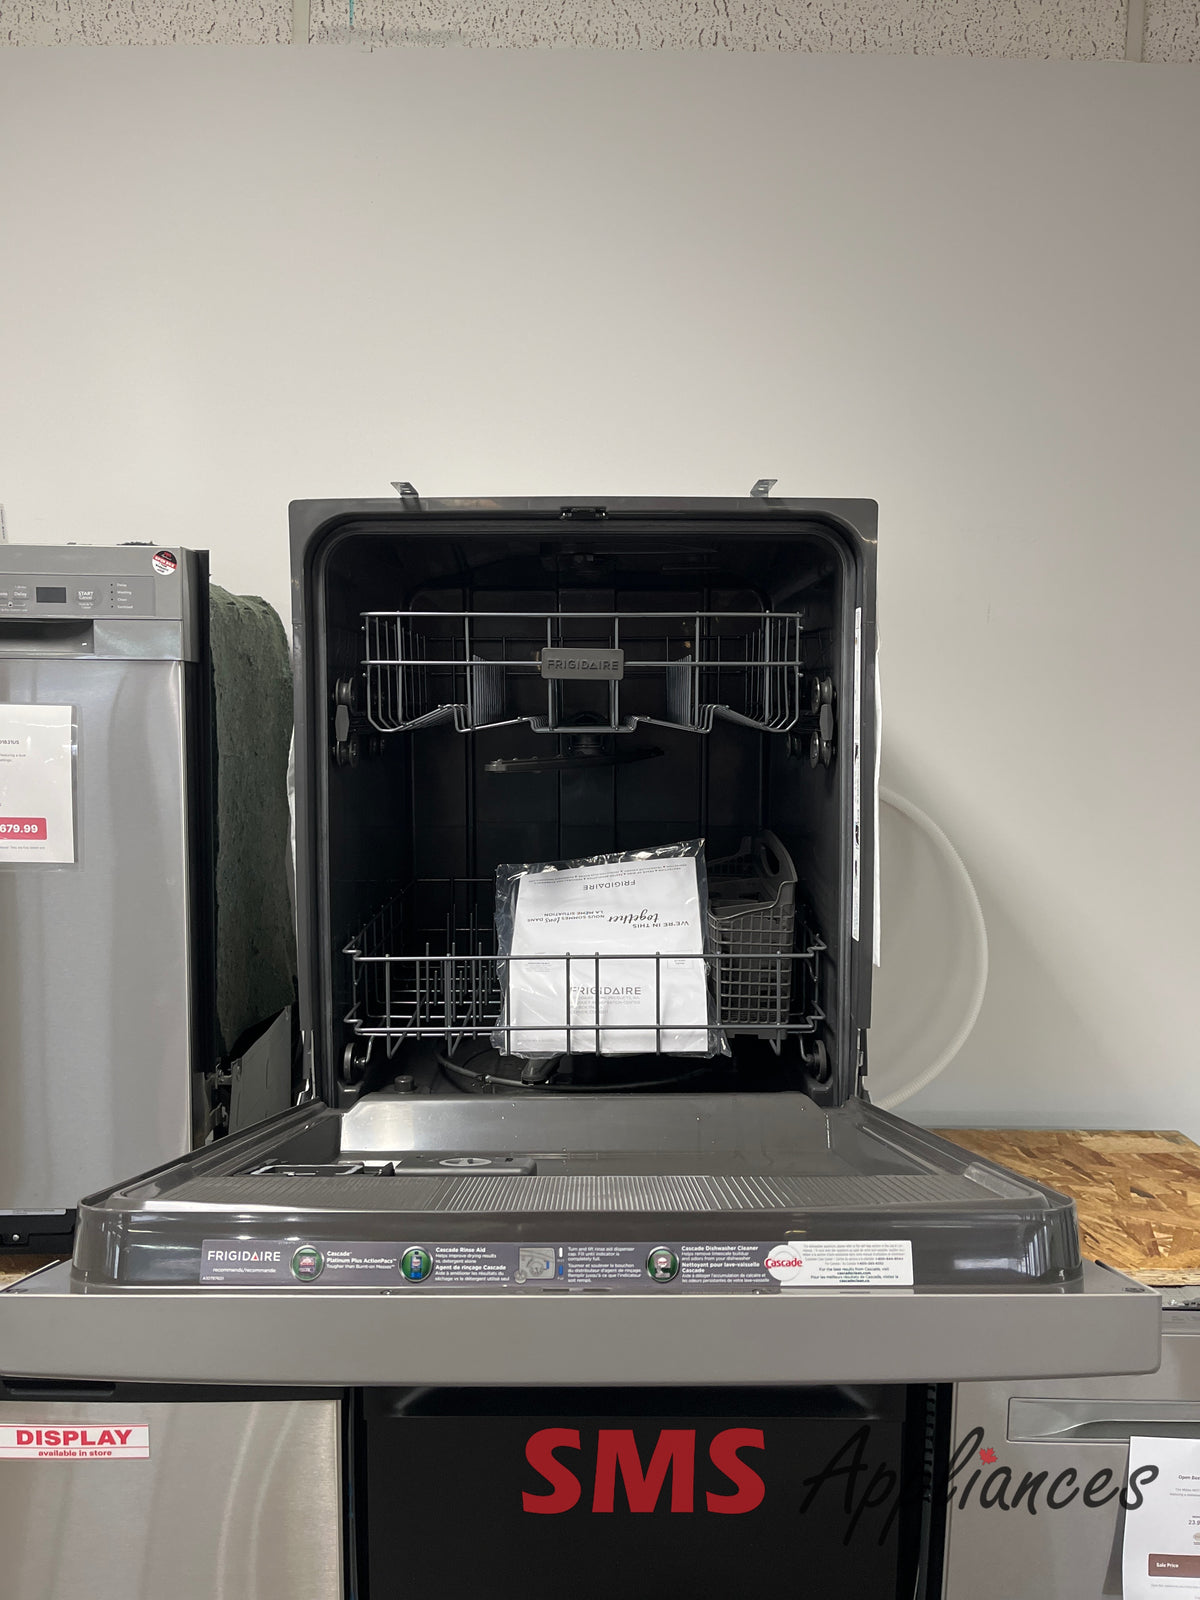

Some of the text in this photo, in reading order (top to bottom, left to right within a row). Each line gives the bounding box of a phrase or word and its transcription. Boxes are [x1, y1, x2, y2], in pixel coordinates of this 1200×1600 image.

[548, 660, 618, 670] FRIGIDAIRE
[583, 880, 636, 891] FRIGIDAIRE
[607, 908, 660, 924] together
[207, 1250, 281, 1262] FRIGIDAIRE
[765, 1258, 803, 1269] Cascade
[16, 1429, 132, 1446] DISPLAY
